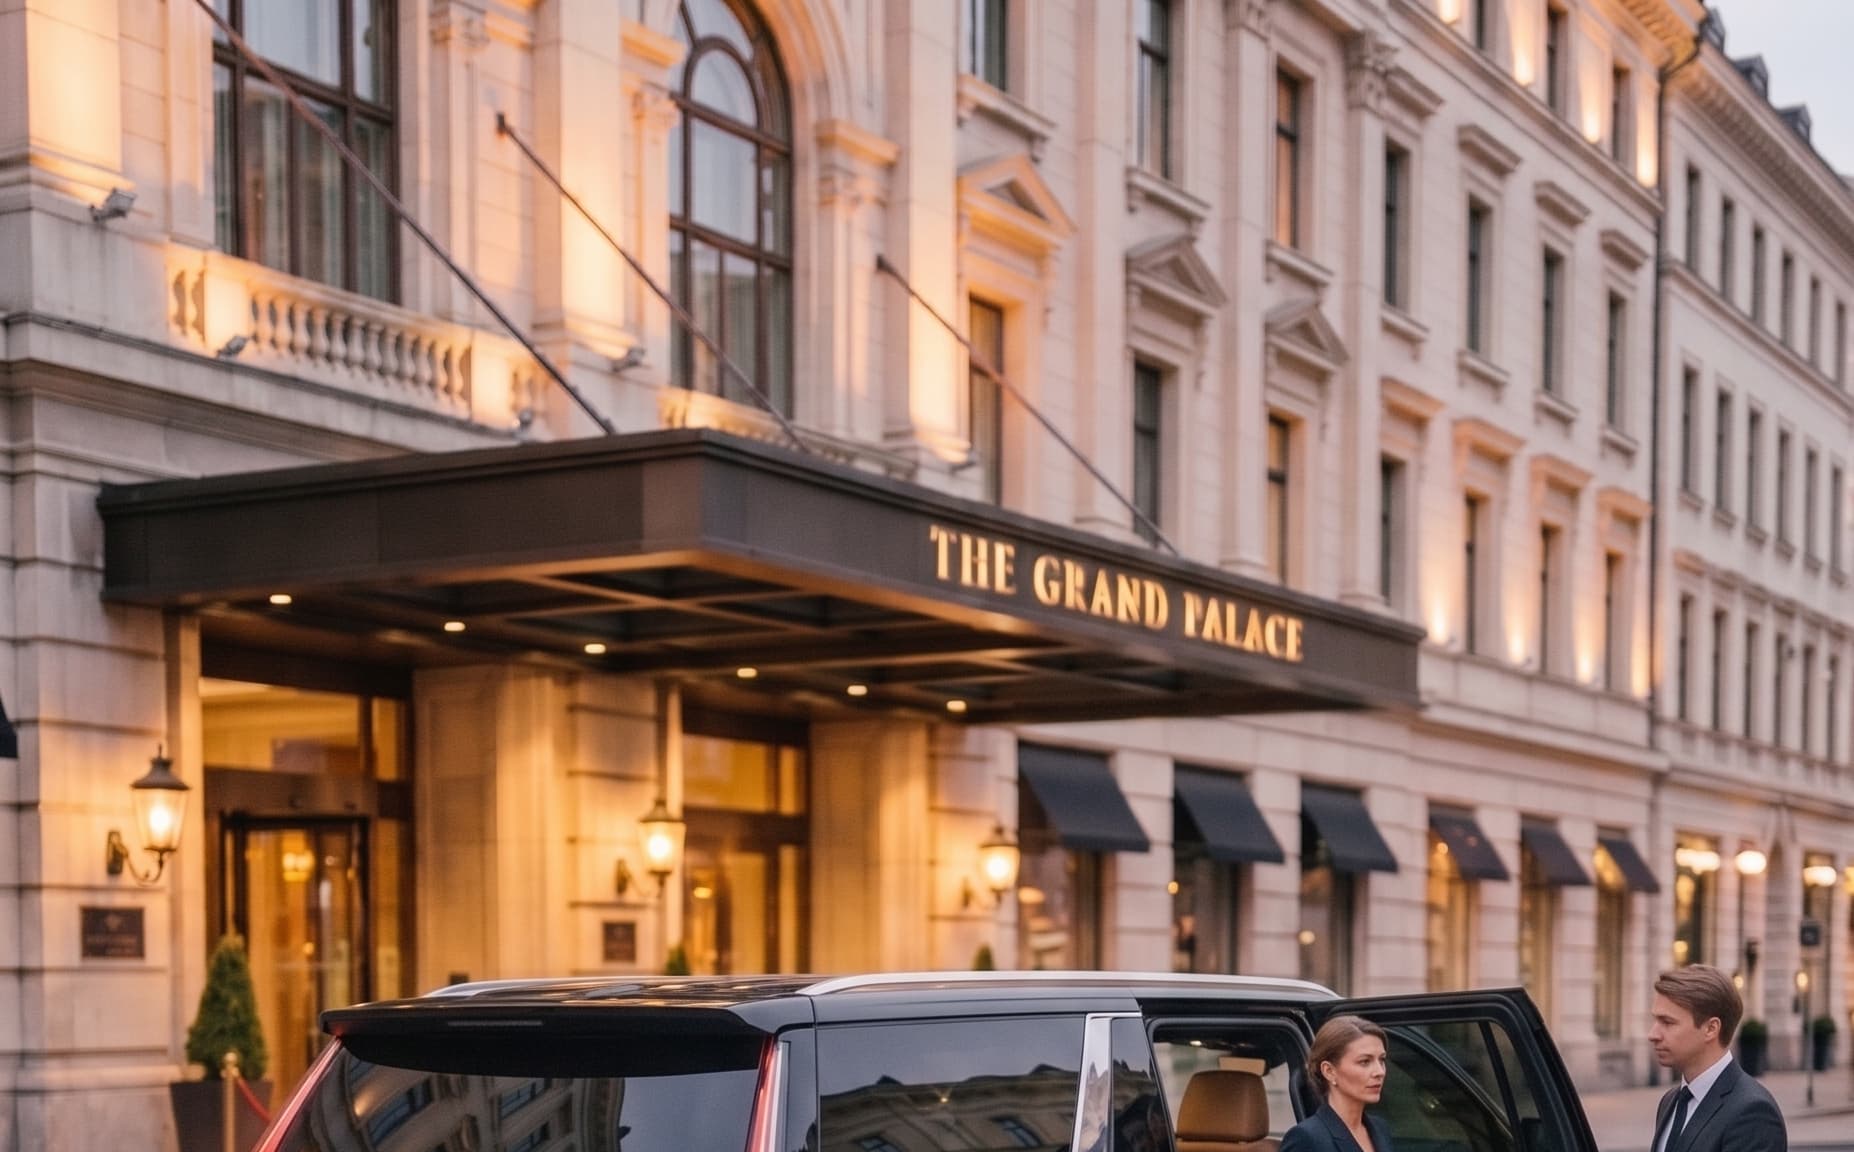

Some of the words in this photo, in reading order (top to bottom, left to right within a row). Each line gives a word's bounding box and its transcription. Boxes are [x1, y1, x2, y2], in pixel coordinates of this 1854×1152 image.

[929, 524, 1016, 595] THE
[1033, 555, 1169, 630] GRAND
[1183, 590, 1304, 662] PALACE
